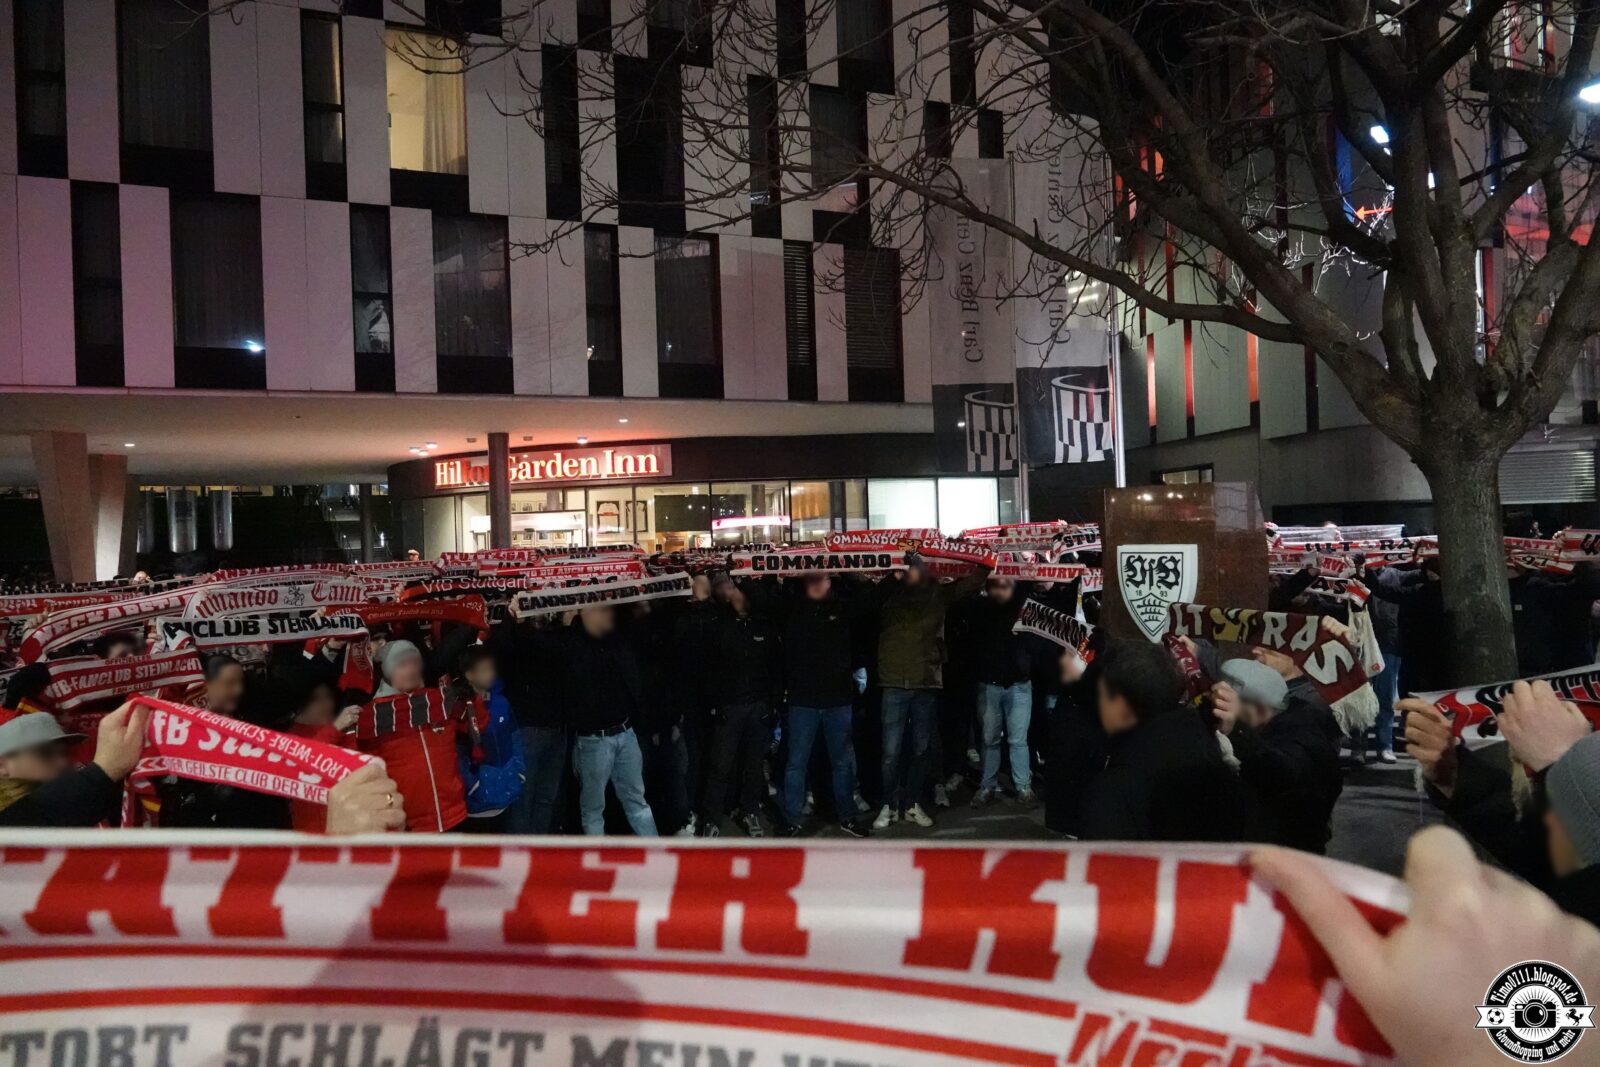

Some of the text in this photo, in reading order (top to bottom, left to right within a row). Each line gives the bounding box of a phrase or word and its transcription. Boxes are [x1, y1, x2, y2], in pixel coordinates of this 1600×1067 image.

[435, 449, 660, 487] Hilto Garden Inn
[1063, 533, 1097, 547] STU
[1305, 537, 1415, 553] ULTRA
[751, 553, 891, 571] COMMANDO
[458, 576, 528, 592] Stuttgart
[519, 587, 640, 611] CANNSTATTER
[643, 577, 691, 594] KURVE
[1159, 590, 1168, 598] 93
[185, 761, 232, 781] GEILSTE
[234, 770, 268, 788] CLUB
[272, 776, 301, 796] DER
[0, 846, 808, 957] ATTER
